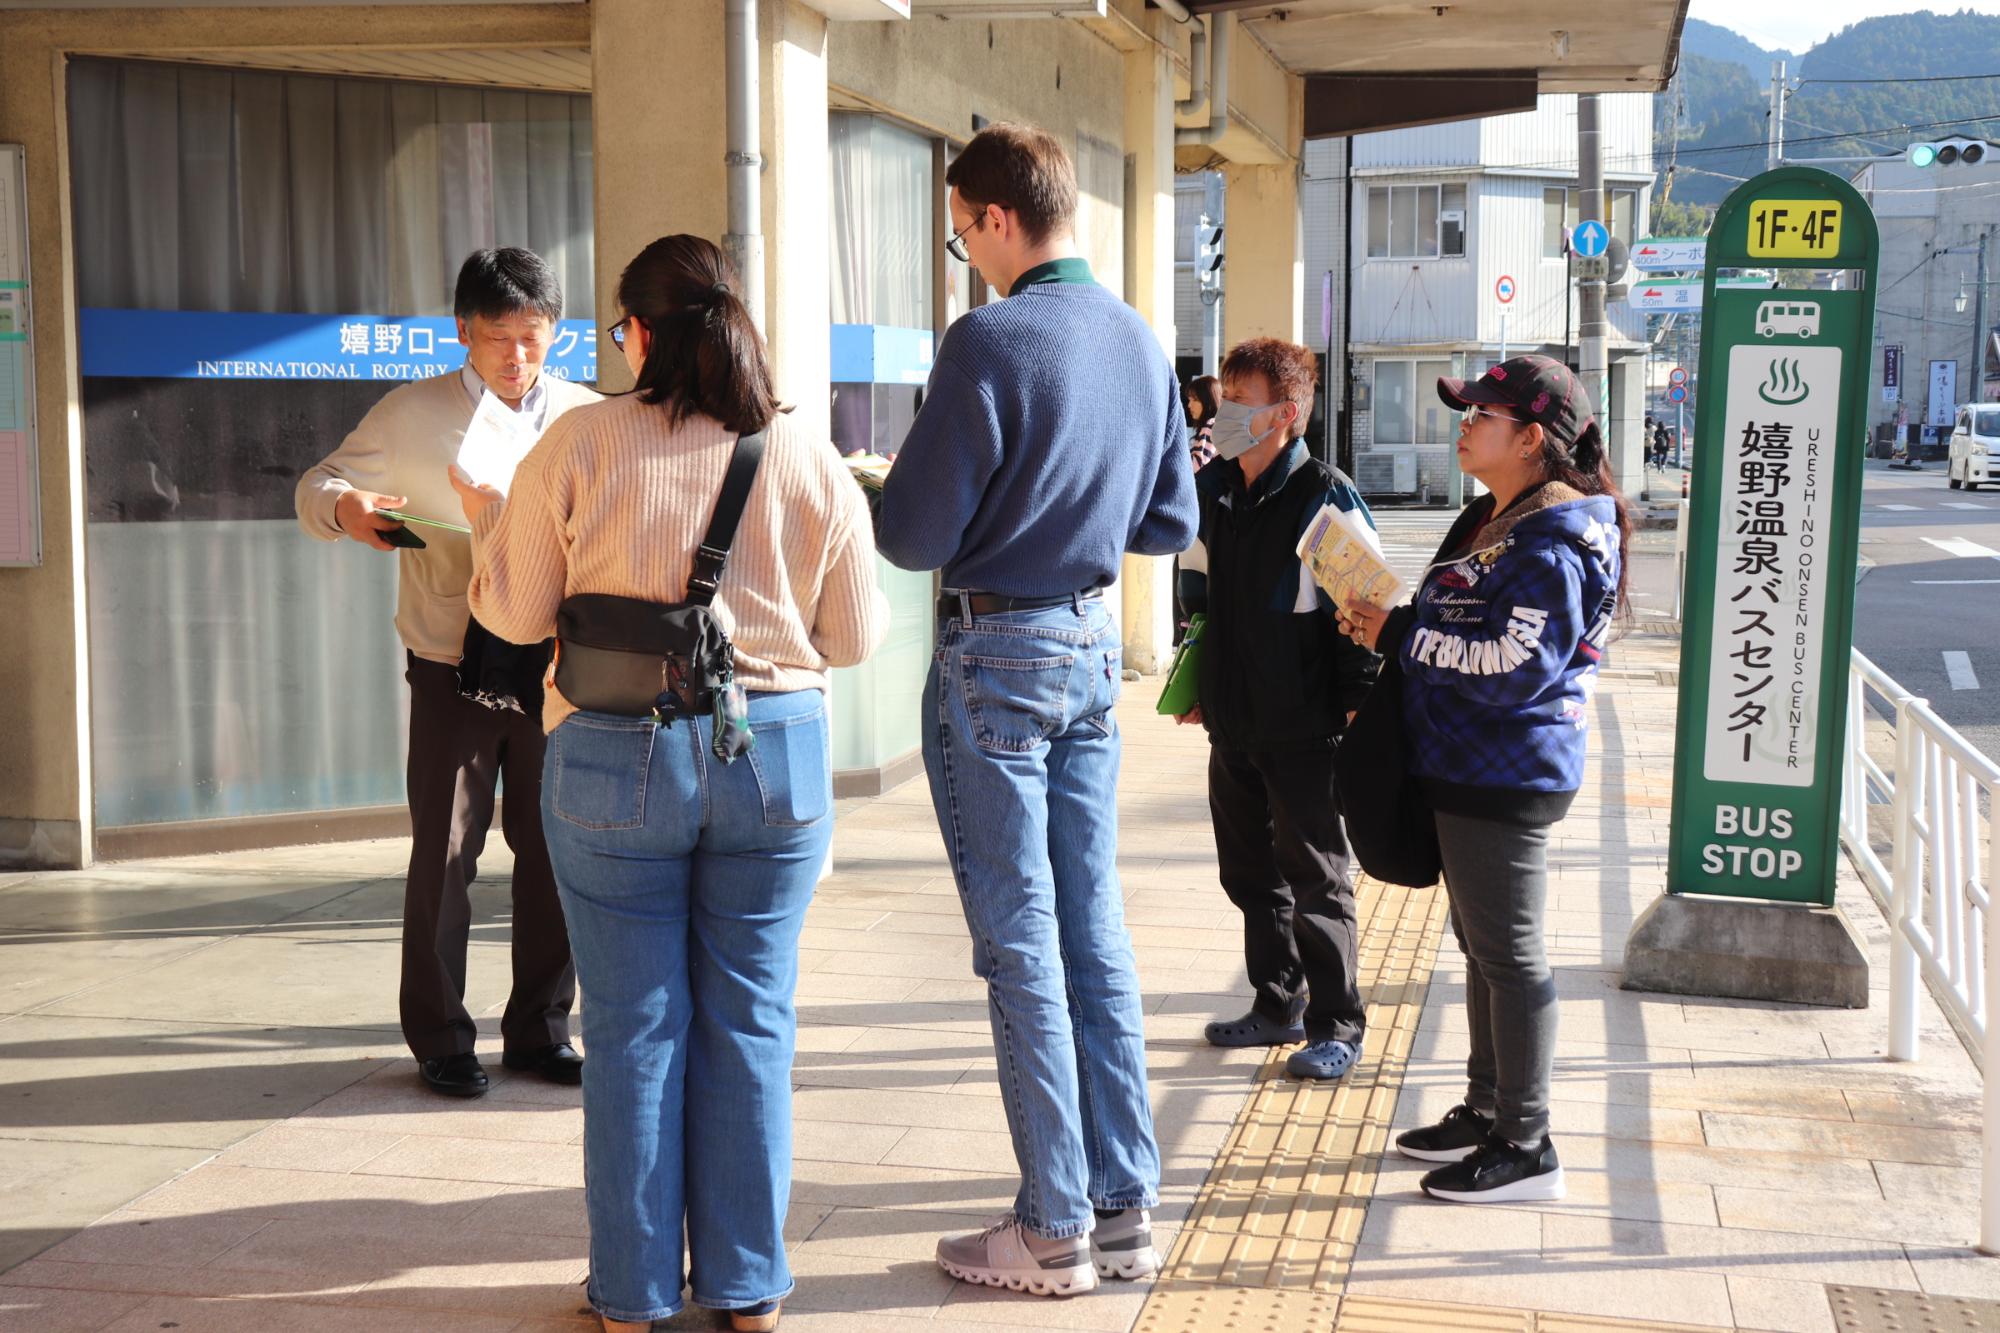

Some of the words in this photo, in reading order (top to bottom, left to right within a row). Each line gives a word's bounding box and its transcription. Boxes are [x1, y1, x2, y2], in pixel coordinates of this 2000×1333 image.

[1634, 256, 1661, 265] 400m
[1662, 246, 1706, 262] シーボ
[197, 360, 360, 378] INTERNATIONAL
[371, 363, 449, 380] ROTARY
[1800, 428, 1820, 547] URESHINO
[1727, 421, 1793, 763] 嬉野温泉バスセンター
[1796, 553, 1812, 626] ONSEN
[1438, 607, 1483, 623] Welcome
[1794, 632, 1805, 675] BUS
[1787, 681, 1803, 768] CENTER
[1715, 805, 1792, 839] BUS
[1701, 844, 1802, 880] STOP
